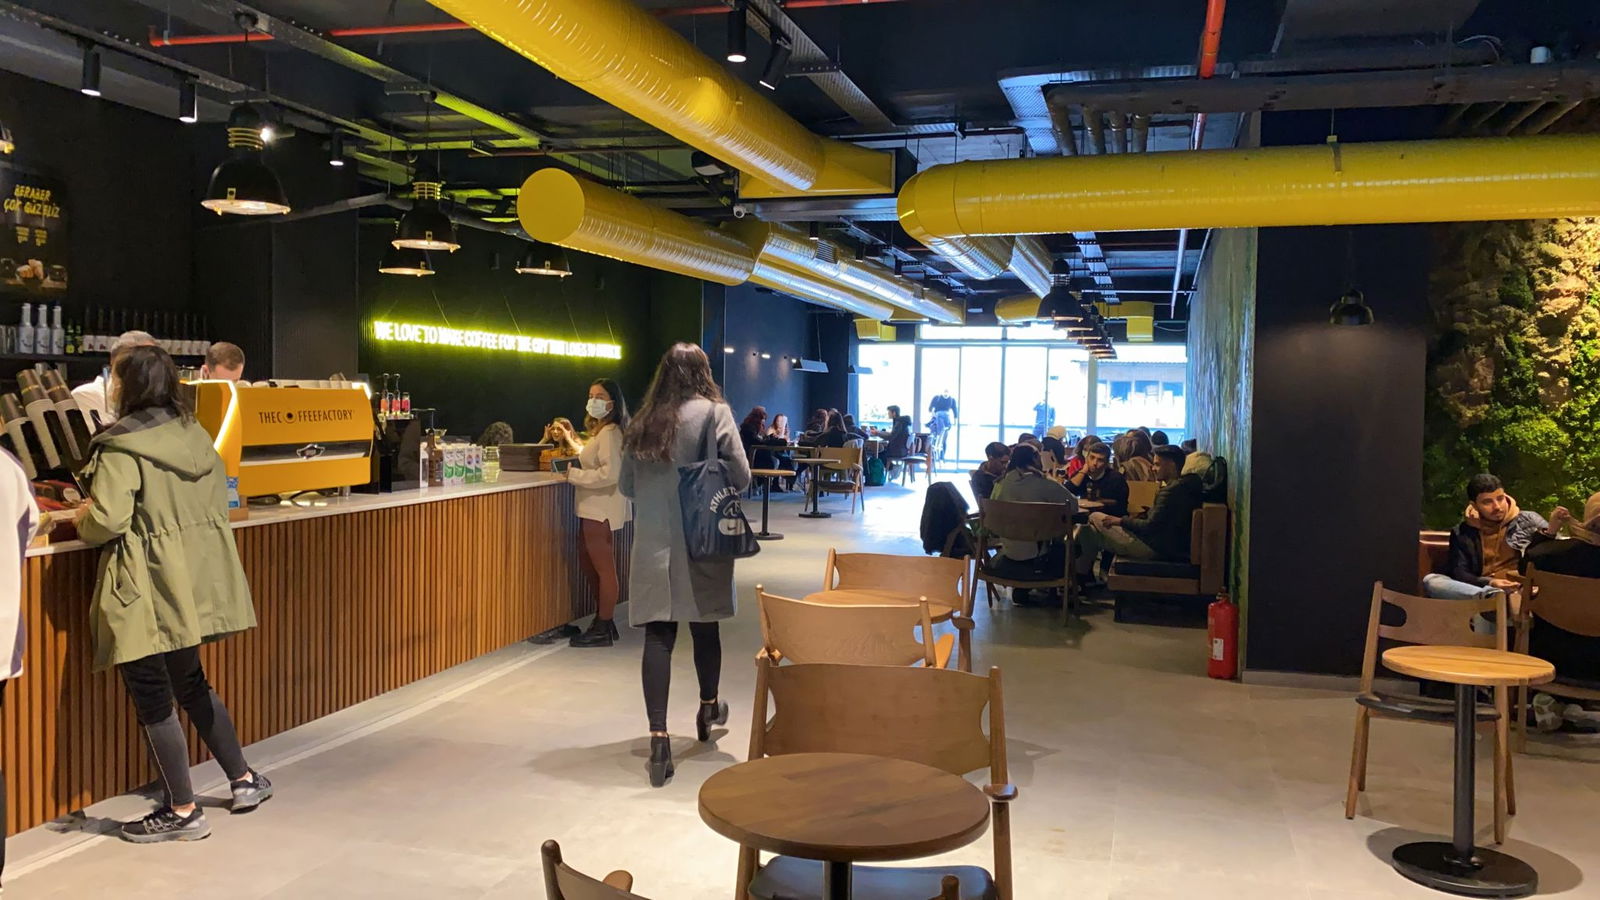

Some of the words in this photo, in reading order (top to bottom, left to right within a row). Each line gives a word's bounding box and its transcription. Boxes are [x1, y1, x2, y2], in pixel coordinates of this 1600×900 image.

[374, 320, 393, 341] WE
[394, 323, 422, 343] LOVE
[422, 325, 438, 345] TO
[438, 326, 464, 347] MAKE
[464, 330, 498, 350] COFFEE
[498, 333, 515, 351] FOR
